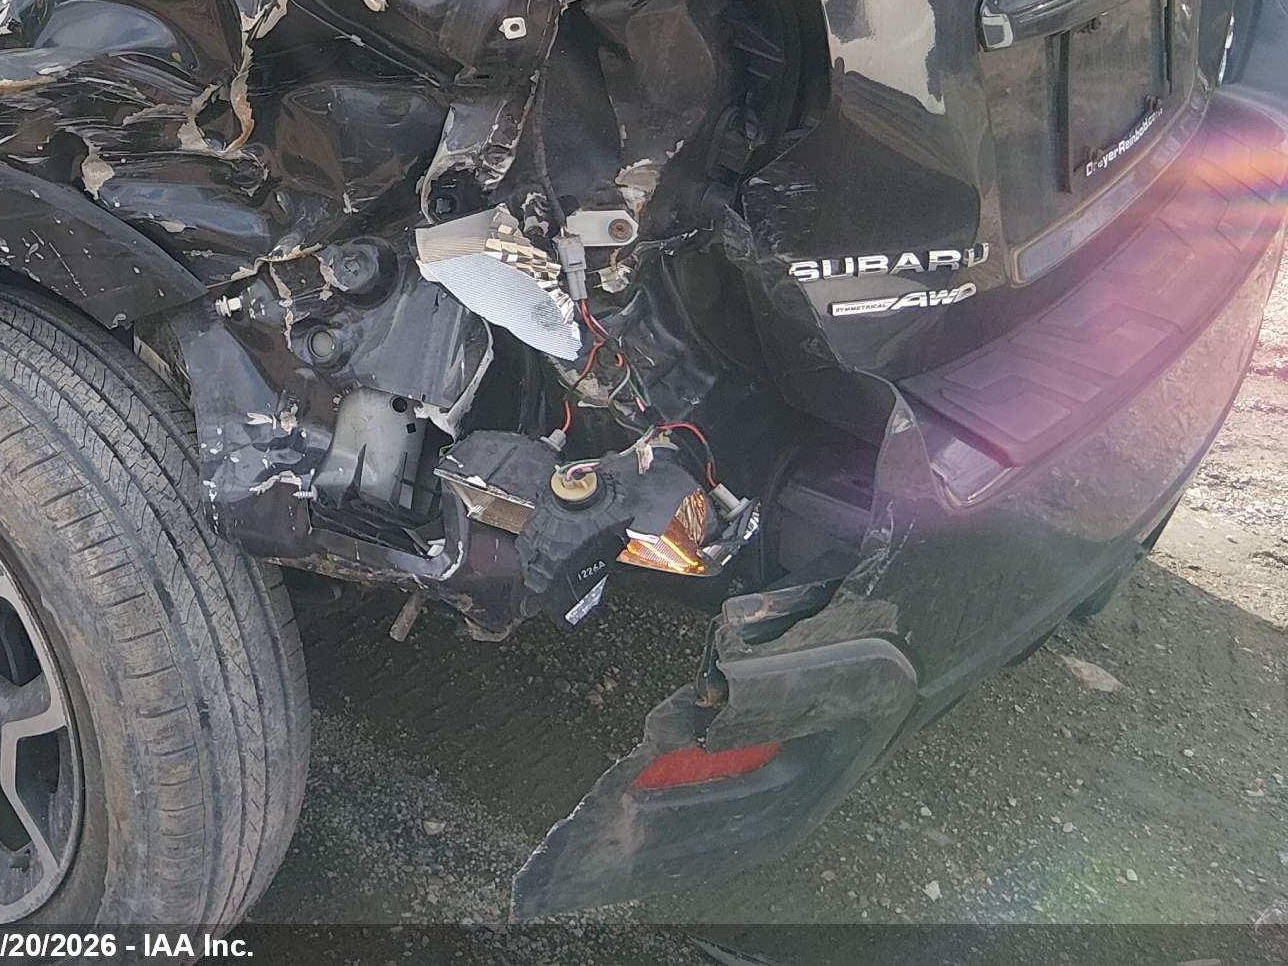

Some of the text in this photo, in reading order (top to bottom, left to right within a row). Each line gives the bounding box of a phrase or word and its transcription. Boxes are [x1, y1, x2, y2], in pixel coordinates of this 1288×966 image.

[788, 242, 990, 283] SUBARU
[835, 283, 977, 314] SYMMETRICAL AWD
[577, 560, 606, 581] 1226A
